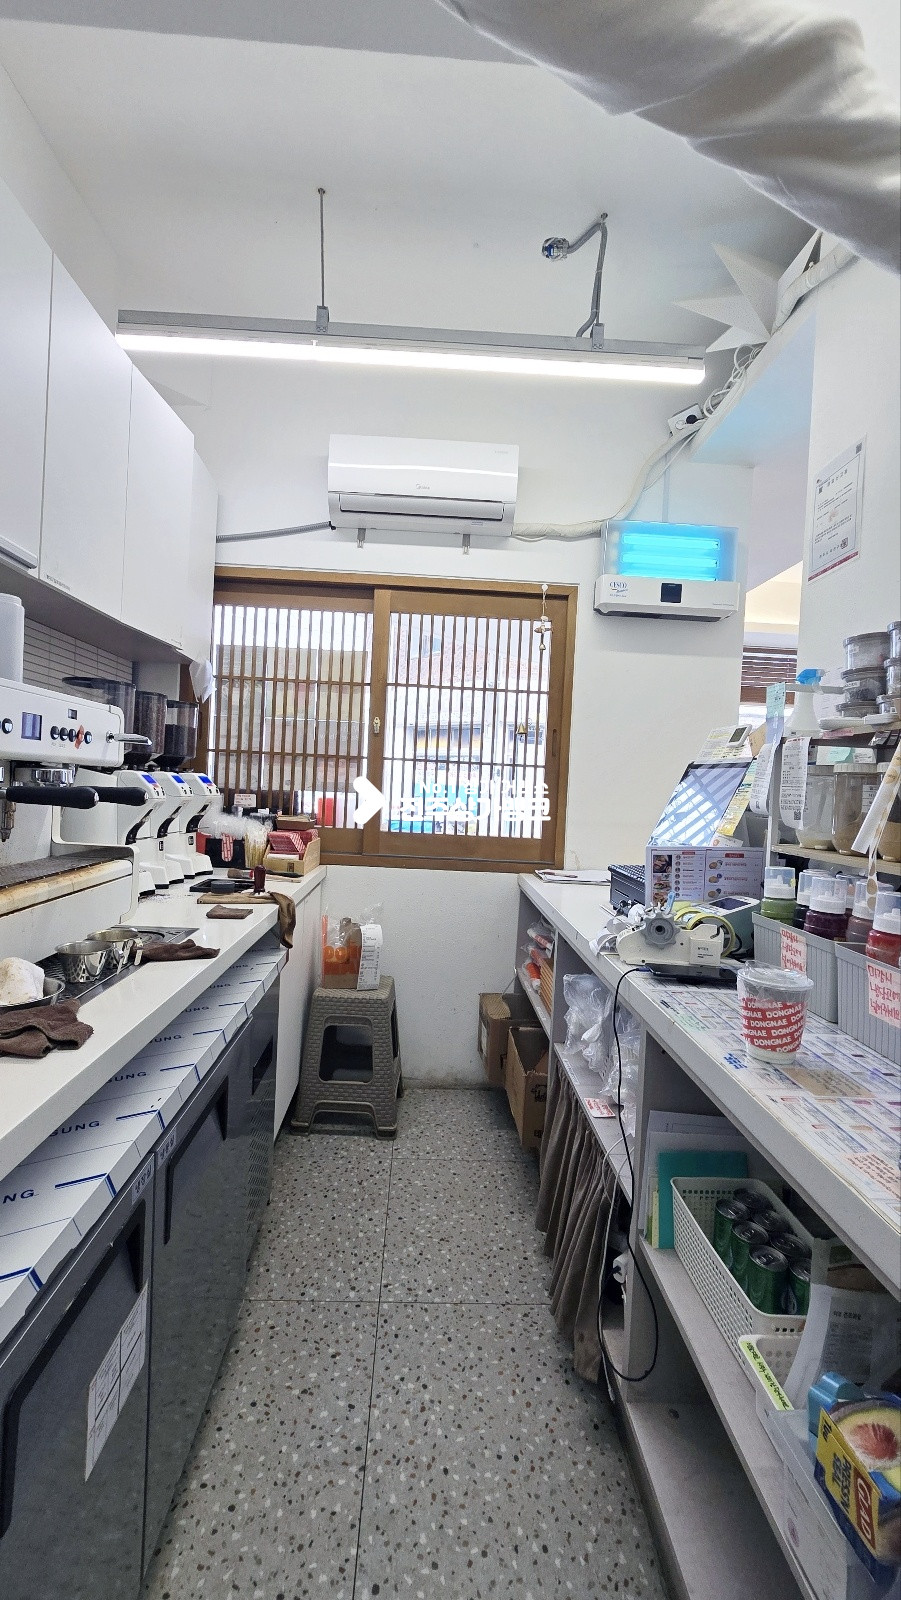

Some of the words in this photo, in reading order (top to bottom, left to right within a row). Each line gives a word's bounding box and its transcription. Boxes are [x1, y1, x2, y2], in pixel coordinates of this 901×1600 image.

[766, 1003, 802, 1018] DONGNAE
[750, 1018, 788, 1027] DONGNAE
[754, 1036, 792, 1046] DONGNAE
[856, 1476, 873, 1541] GLAD
